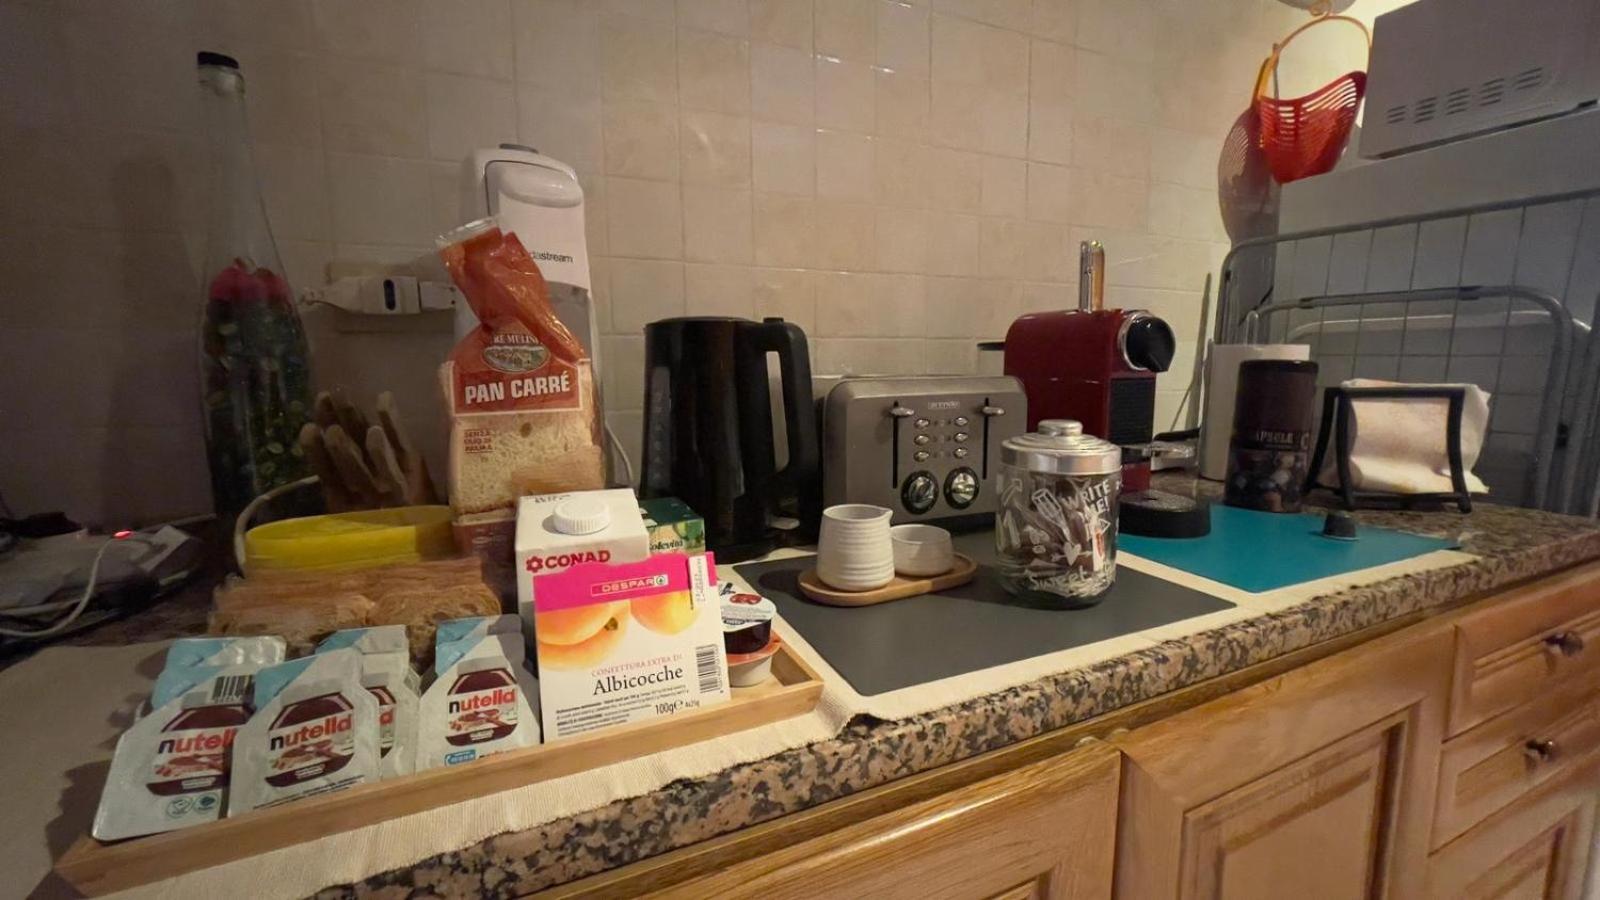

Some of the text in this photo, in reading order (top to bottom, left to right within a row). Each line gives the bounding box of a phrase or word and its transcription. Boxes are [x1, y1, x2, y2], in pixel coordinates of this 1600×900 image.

[465, 371, 570, 404] PAN CARRÉ
[545, 550, 611, 569] CONAD
[601, 578, 654, 593] DESPAR
[593, 665, 683, 695] Albicocche
[449, 688, 516, 714] nutella
[157, 728, 238, 755] nutell
[270, 716, 352, 751] nutella
